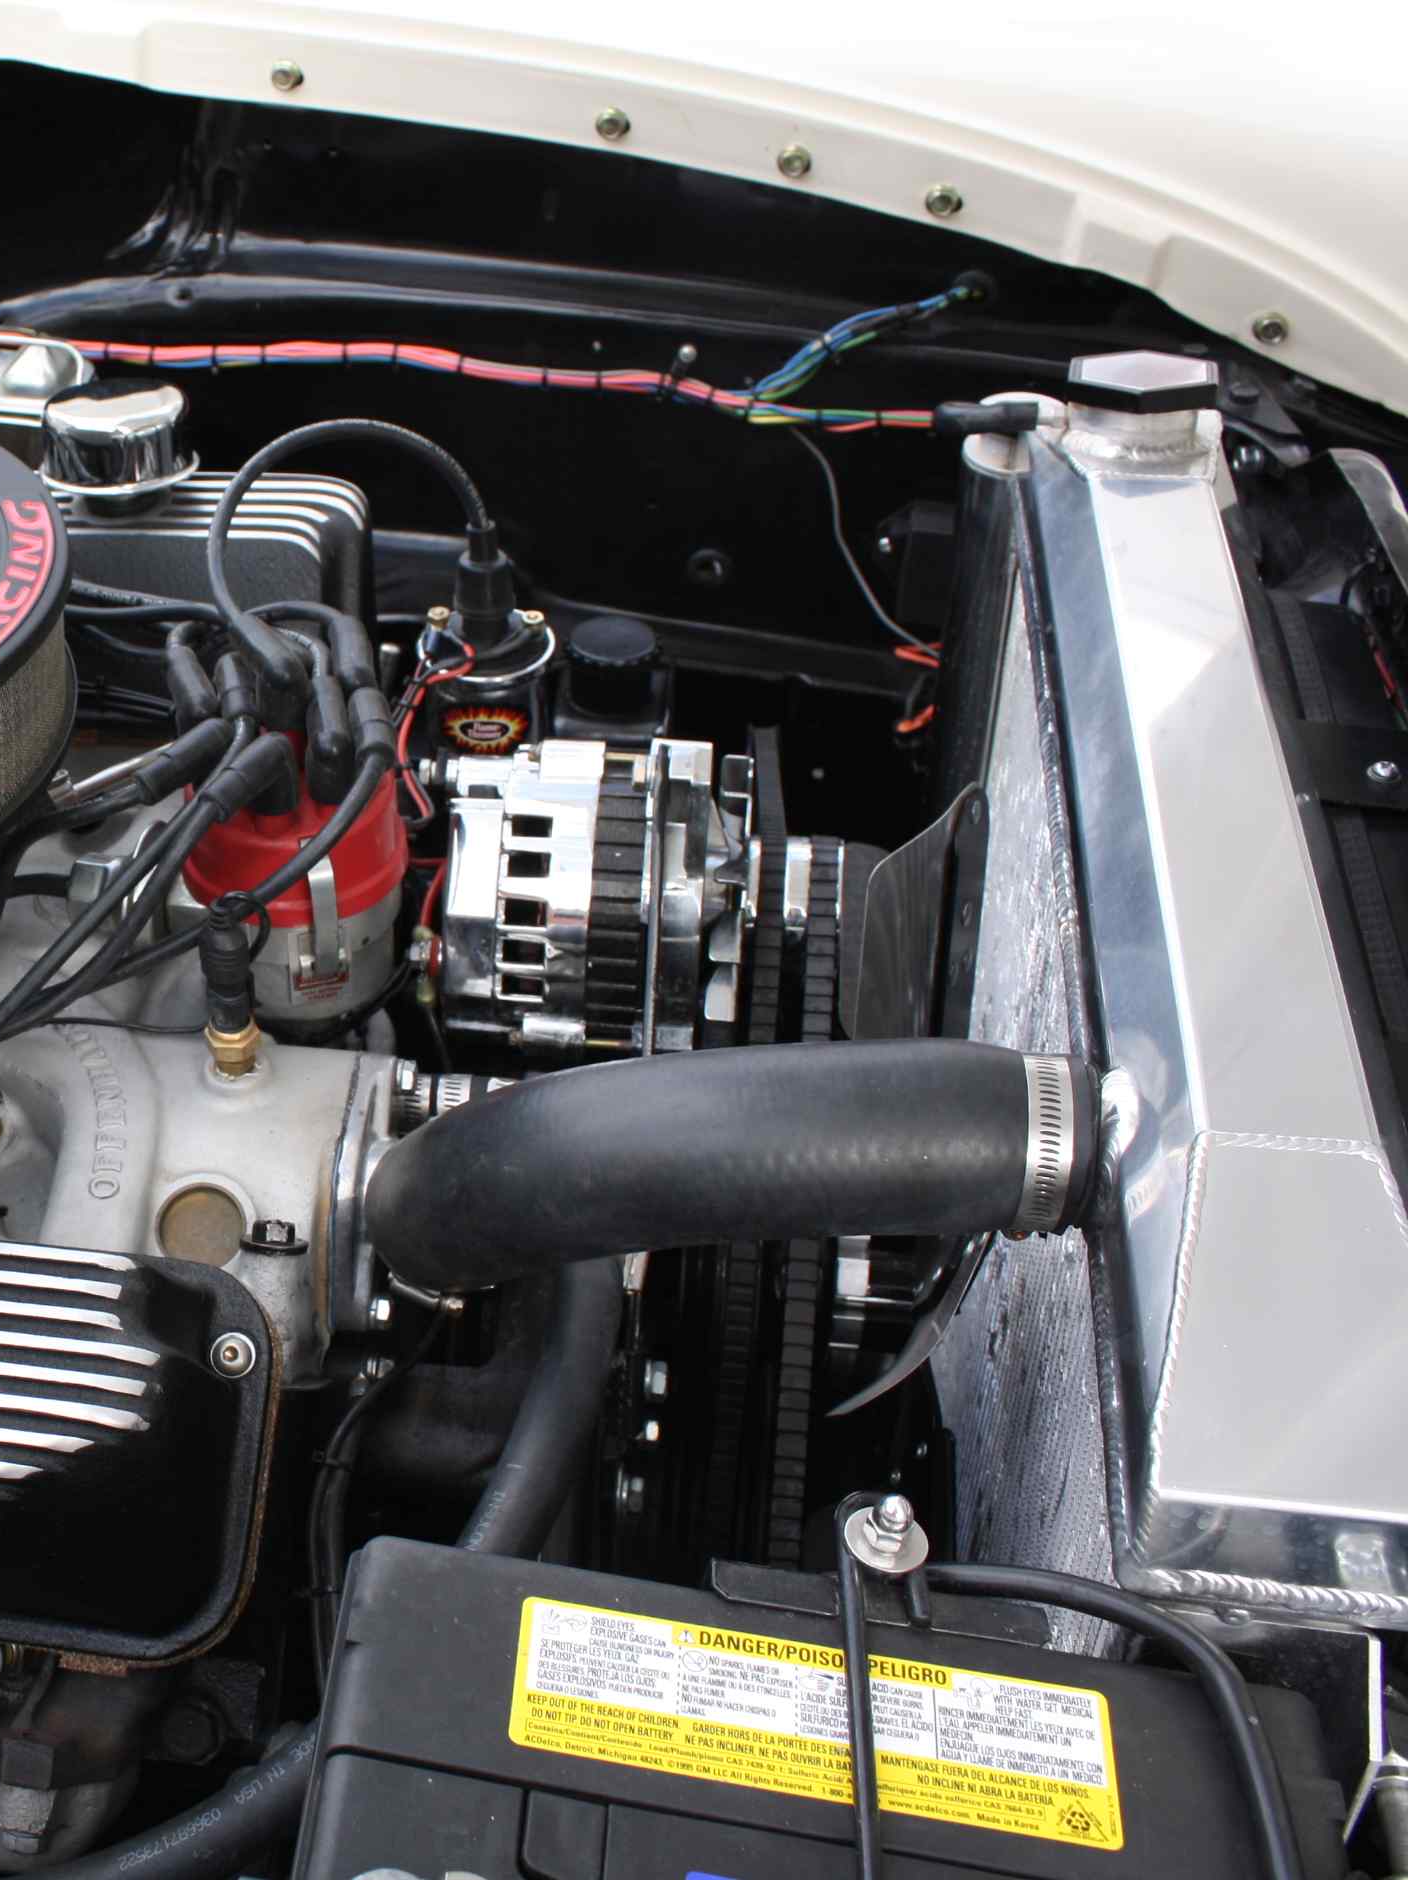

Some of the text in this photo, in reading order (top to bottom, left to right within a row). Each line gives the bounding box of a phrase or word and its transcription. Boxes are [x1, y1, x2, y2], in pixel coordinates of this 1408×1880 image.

[589, 1626, 627, 1642] EXPLOSIVE
[628, 1632, 653, 1646] GASES
[698, 1629, 947, 1686] DANGER/POISO PELIGRO
[1022, 1687, 1041, 1701] EYES
[526, 1692, 548, 1706] KEEP
[596, 1704, 625, 1719] REACH
[992, 1693, 1013, 1706] WITH
[1060, 1704, 1094, 1720] MEDICAL
[994, 1704, 1013, 1717] HELP
[612, 1720, 635, 1735] OPEN
[692, 1721, 725, 1737] GARDER
[727, 1727, 751, 1741] HORS
[931, 1775, 964, 1792] INCLINE
[978, 1783, 1002, 1798] ABRA
[941, 1763, 969, 1779] FUERA
[988, 1771, 1029, 1789] ALCANCE
